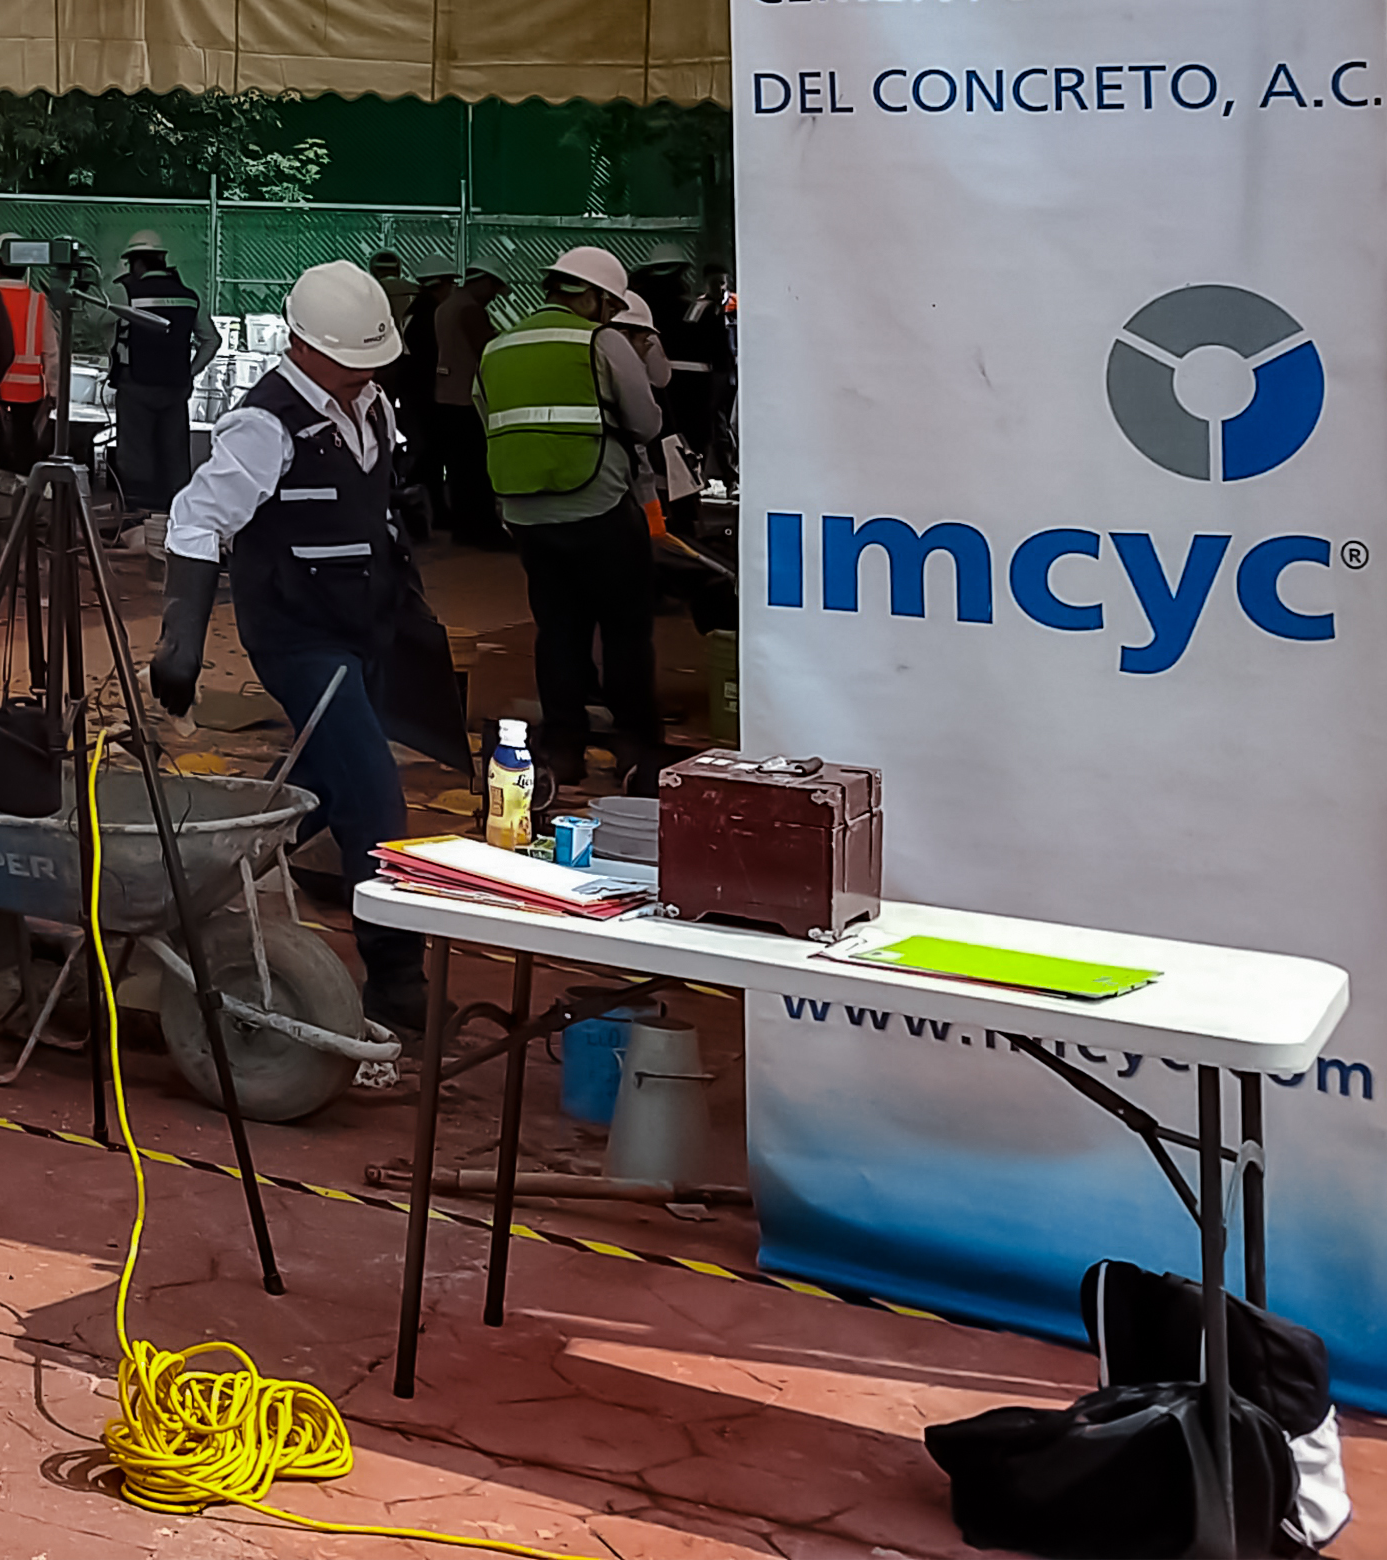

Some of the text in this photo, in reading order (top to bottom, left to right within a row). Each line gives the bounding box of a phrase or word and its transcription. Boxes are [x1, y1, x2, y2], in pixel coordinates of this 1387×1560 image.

[753, 61, 1383, 117] DEL CONCRETO, A.C.
